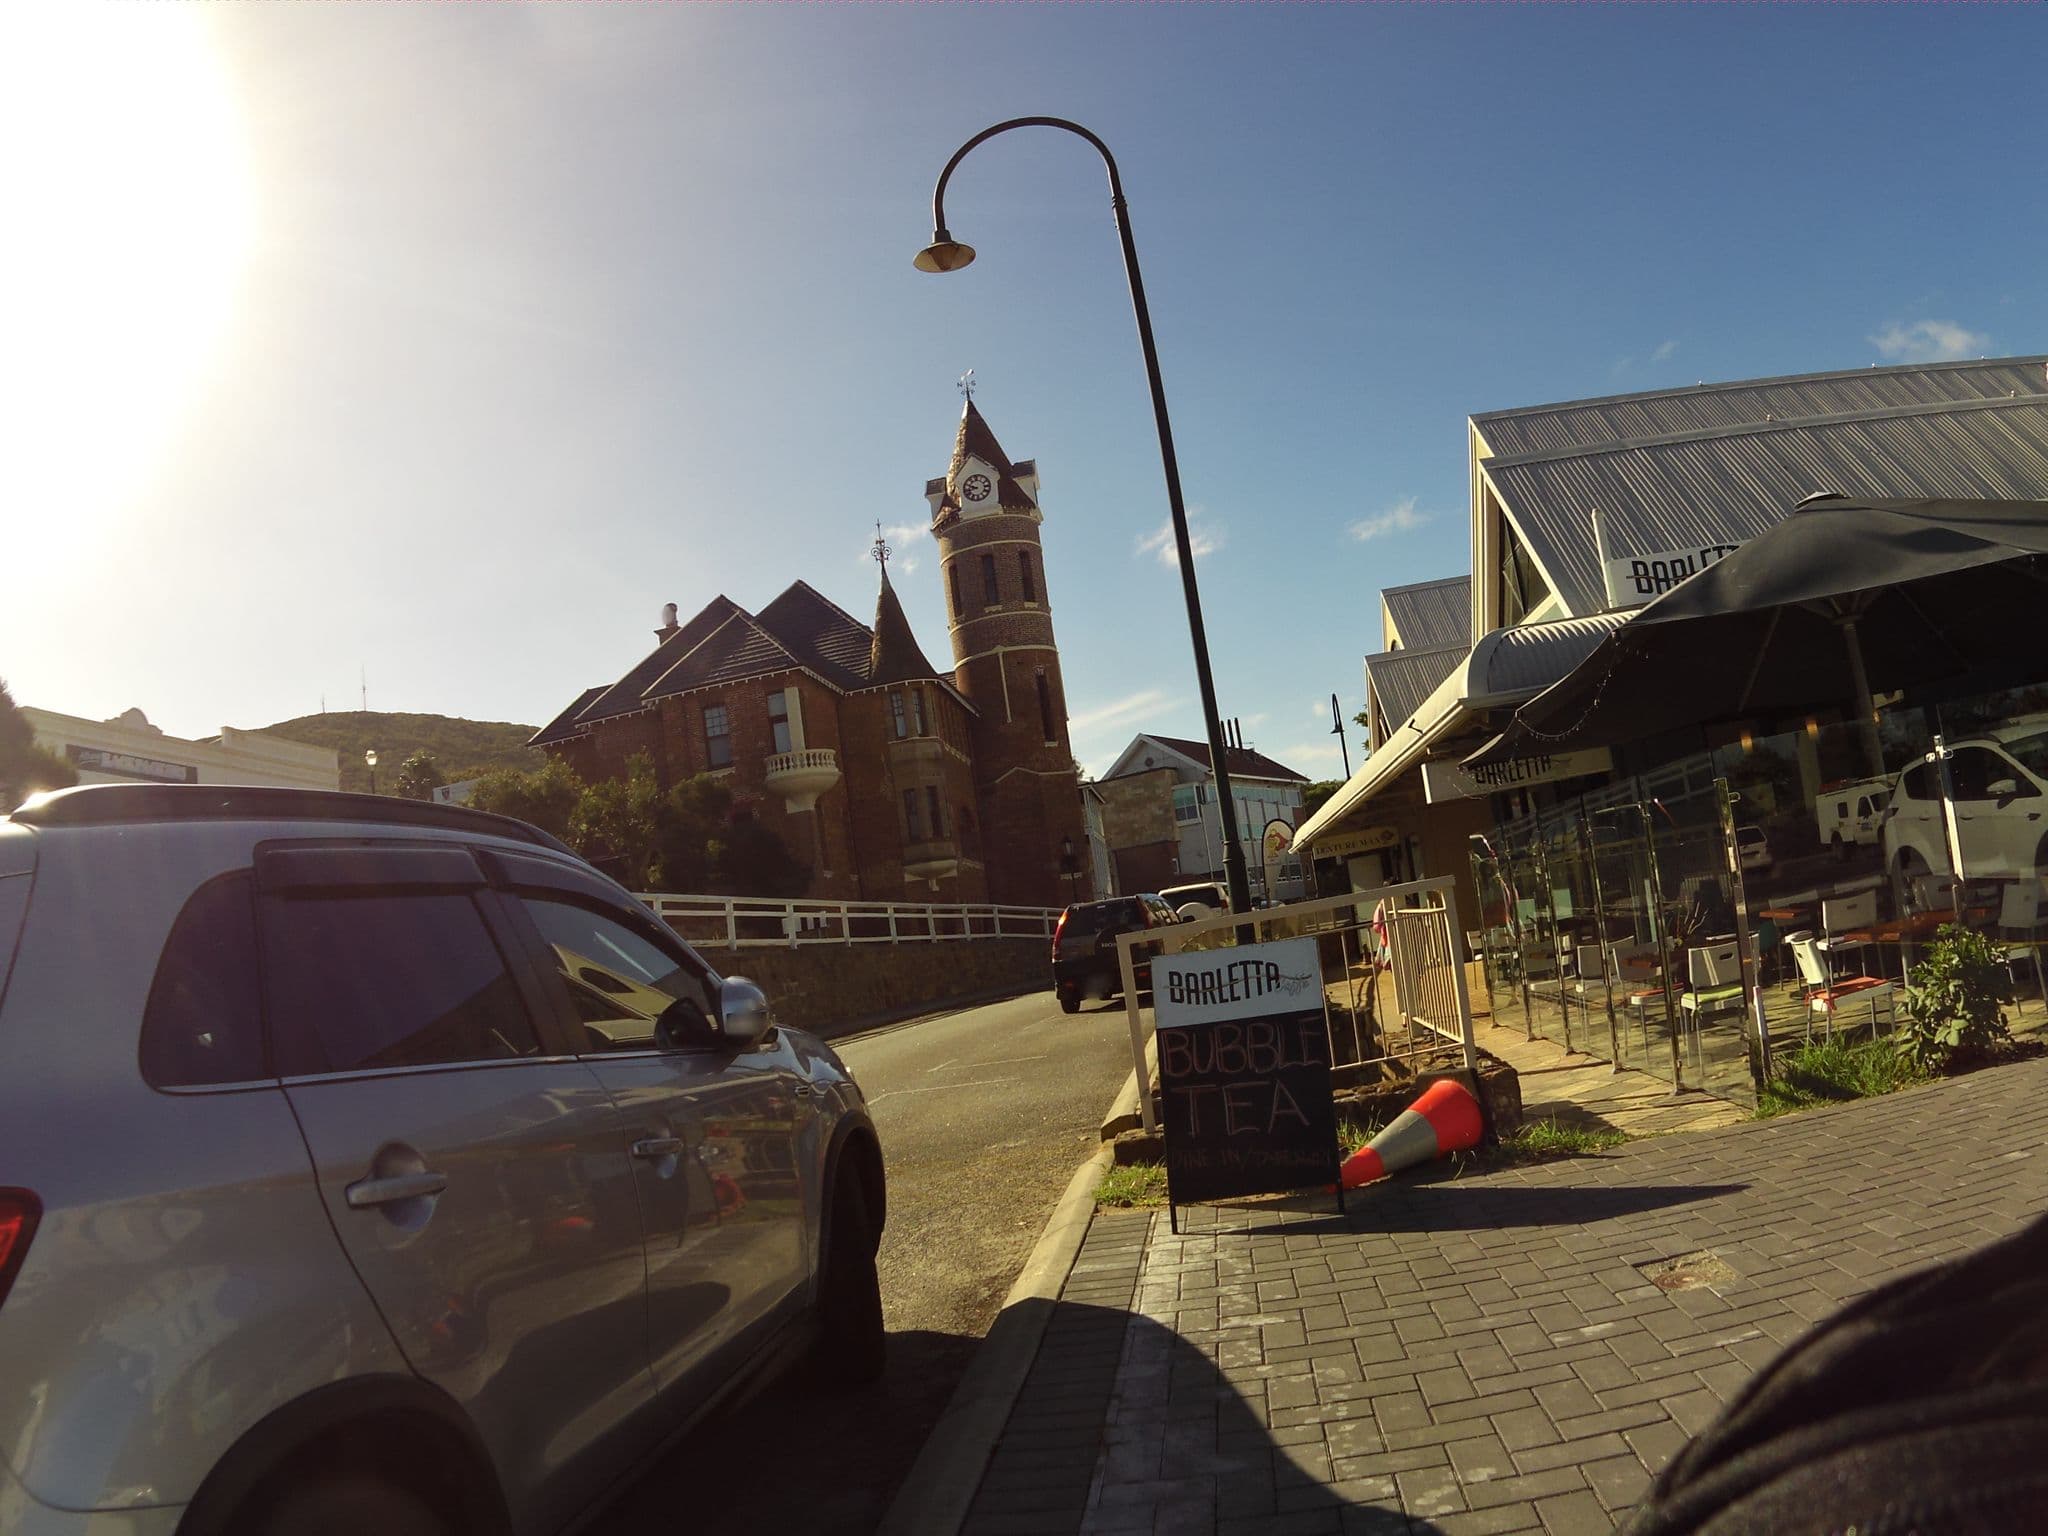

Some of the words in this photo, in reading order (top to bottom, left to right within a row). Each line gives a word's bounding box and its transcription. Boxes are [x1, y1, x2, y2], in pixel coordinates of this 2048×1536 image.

[1168, 960, 1280, 1006] BARLETTA
[1161, 1017, 1322, 1077] BUBBLE
[1170, 1080, 1310, 1138] TEA
